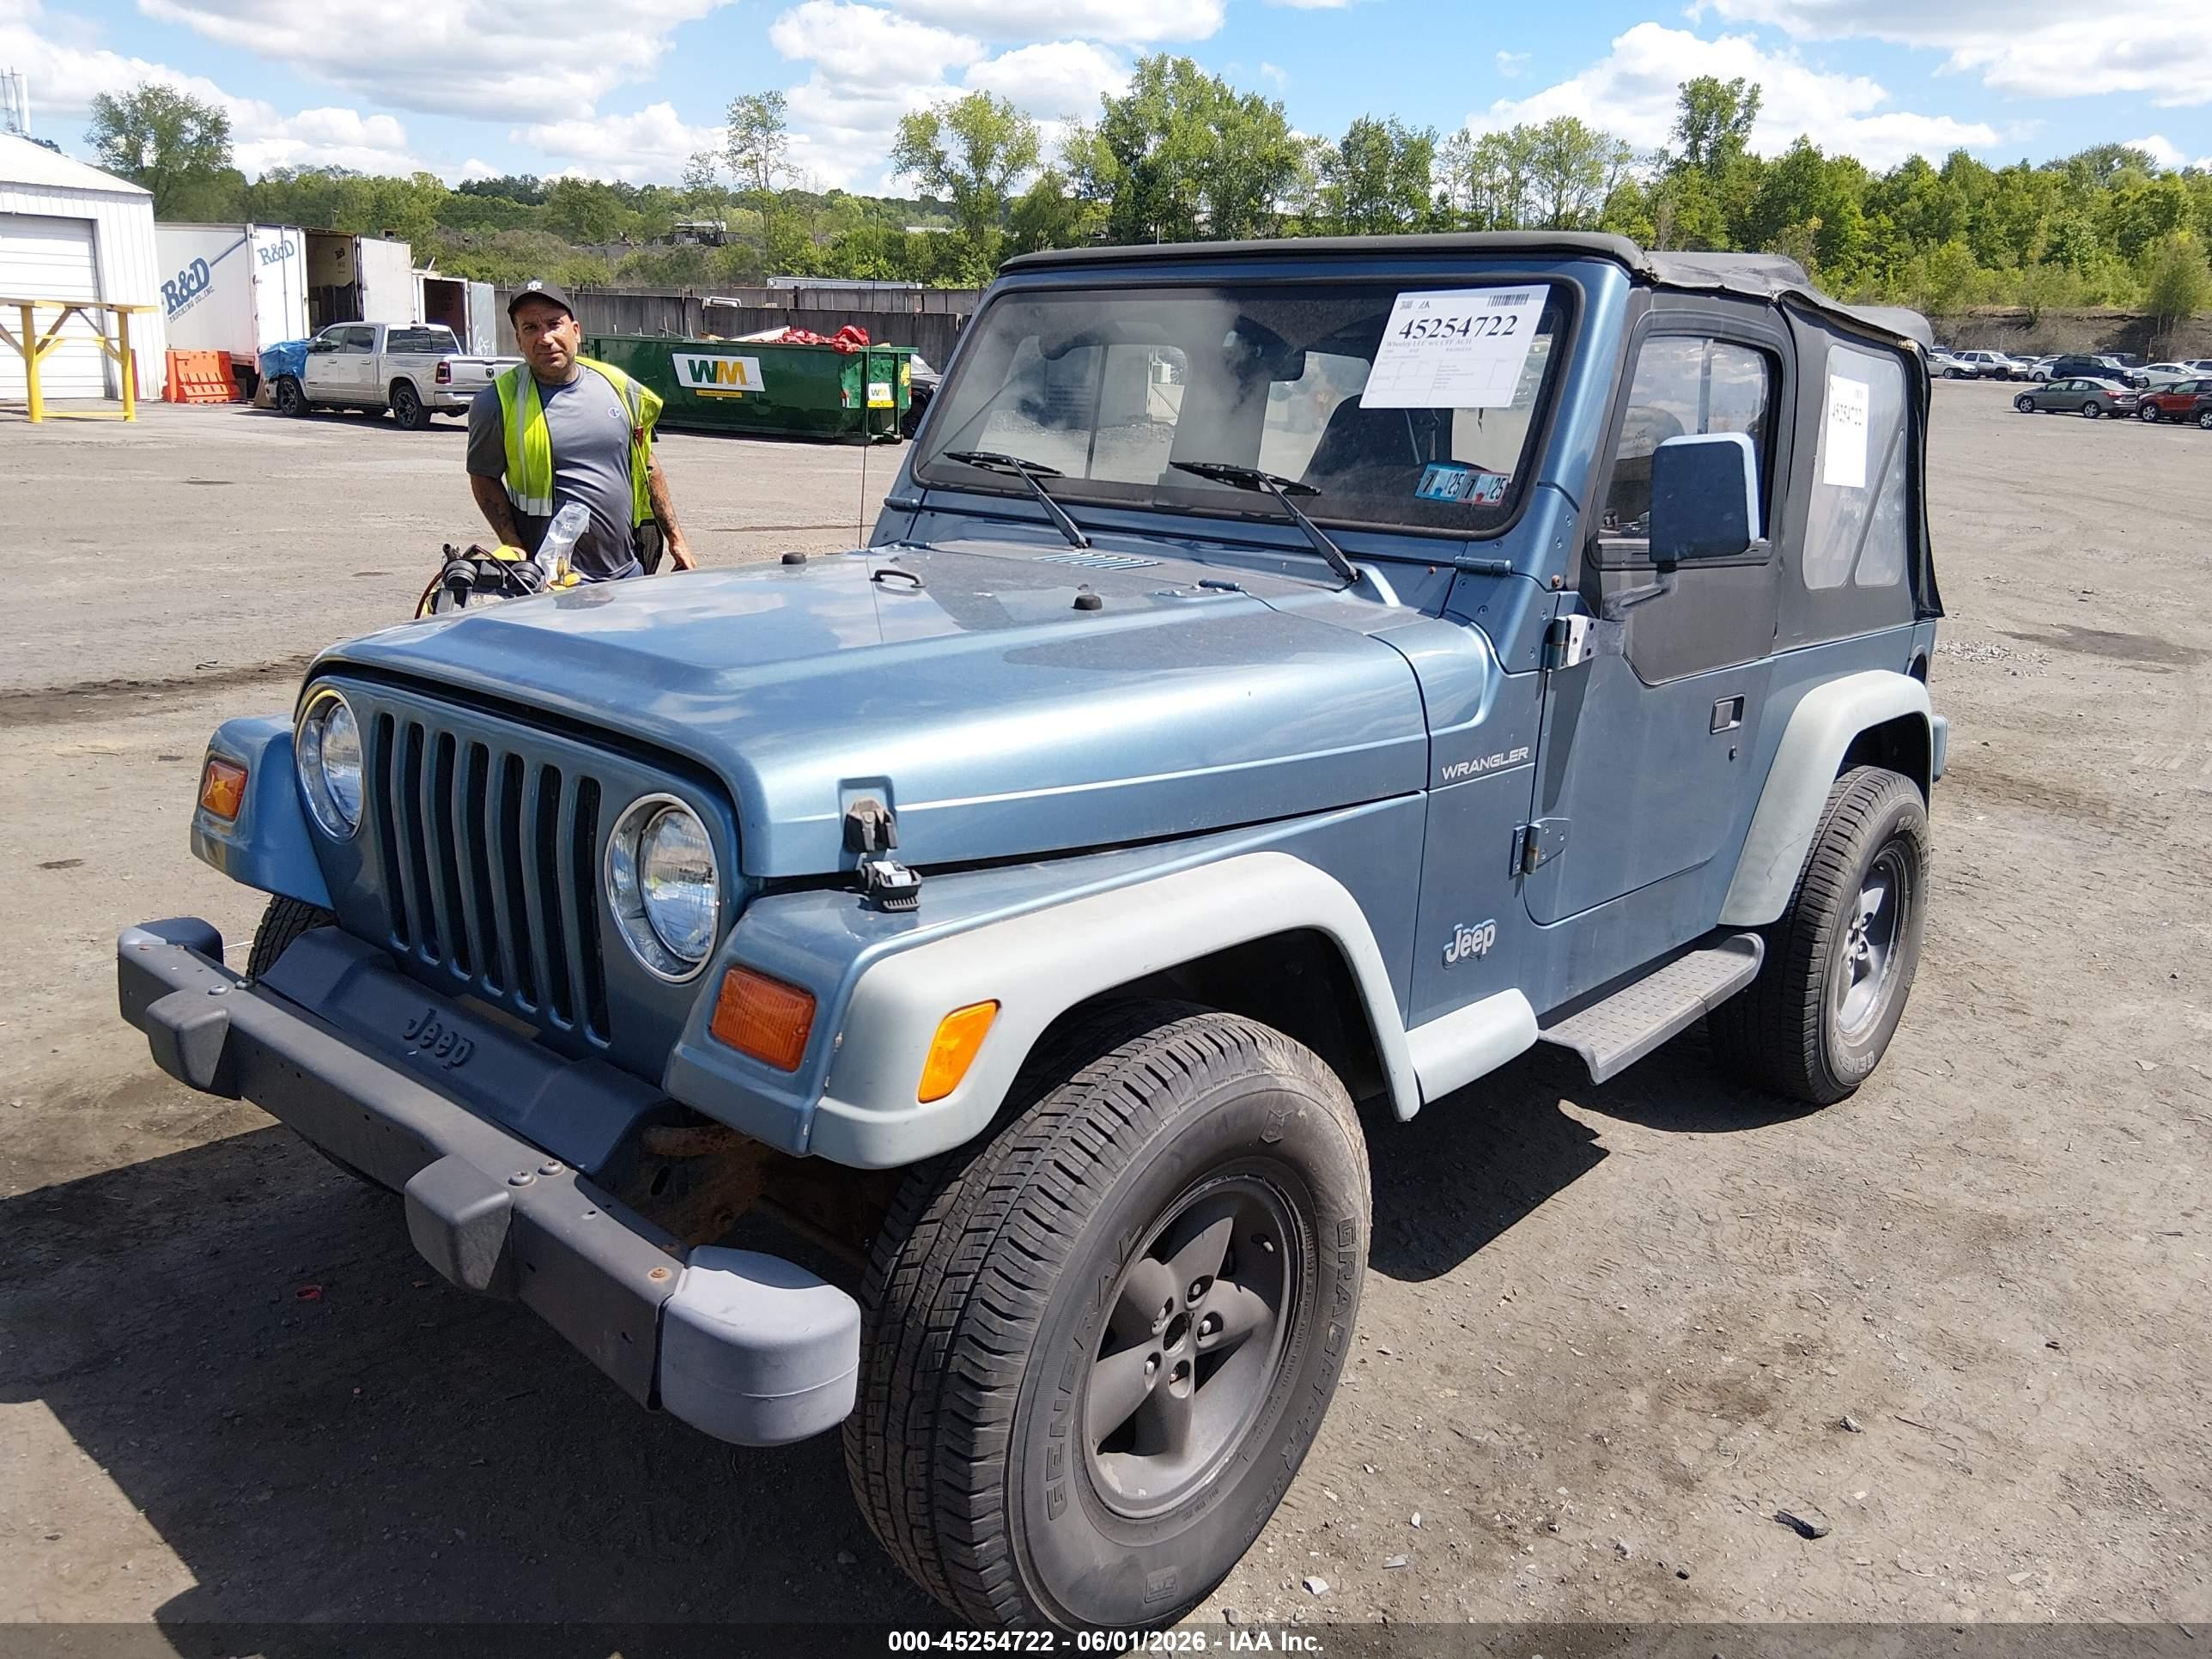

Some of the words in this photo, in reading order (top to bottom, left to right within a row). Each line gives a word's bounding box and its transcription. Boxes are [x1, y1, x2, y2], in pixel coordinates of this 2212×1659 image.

[258, 240, 295, 266] R&D
[161, 258, 210, 315] R&D
[1398, 315, 1518, 339] 45254722
[687, 359, 747, 386] WM
[1448, 473, 1465, 495] 25
[1489, 477, 1507, 500] 25
[1442, 746, 1529, 781] WRANGLER
[1444, 921, 1497, 963] Jeep
[403, 1008, 475, 1070] Jeep
